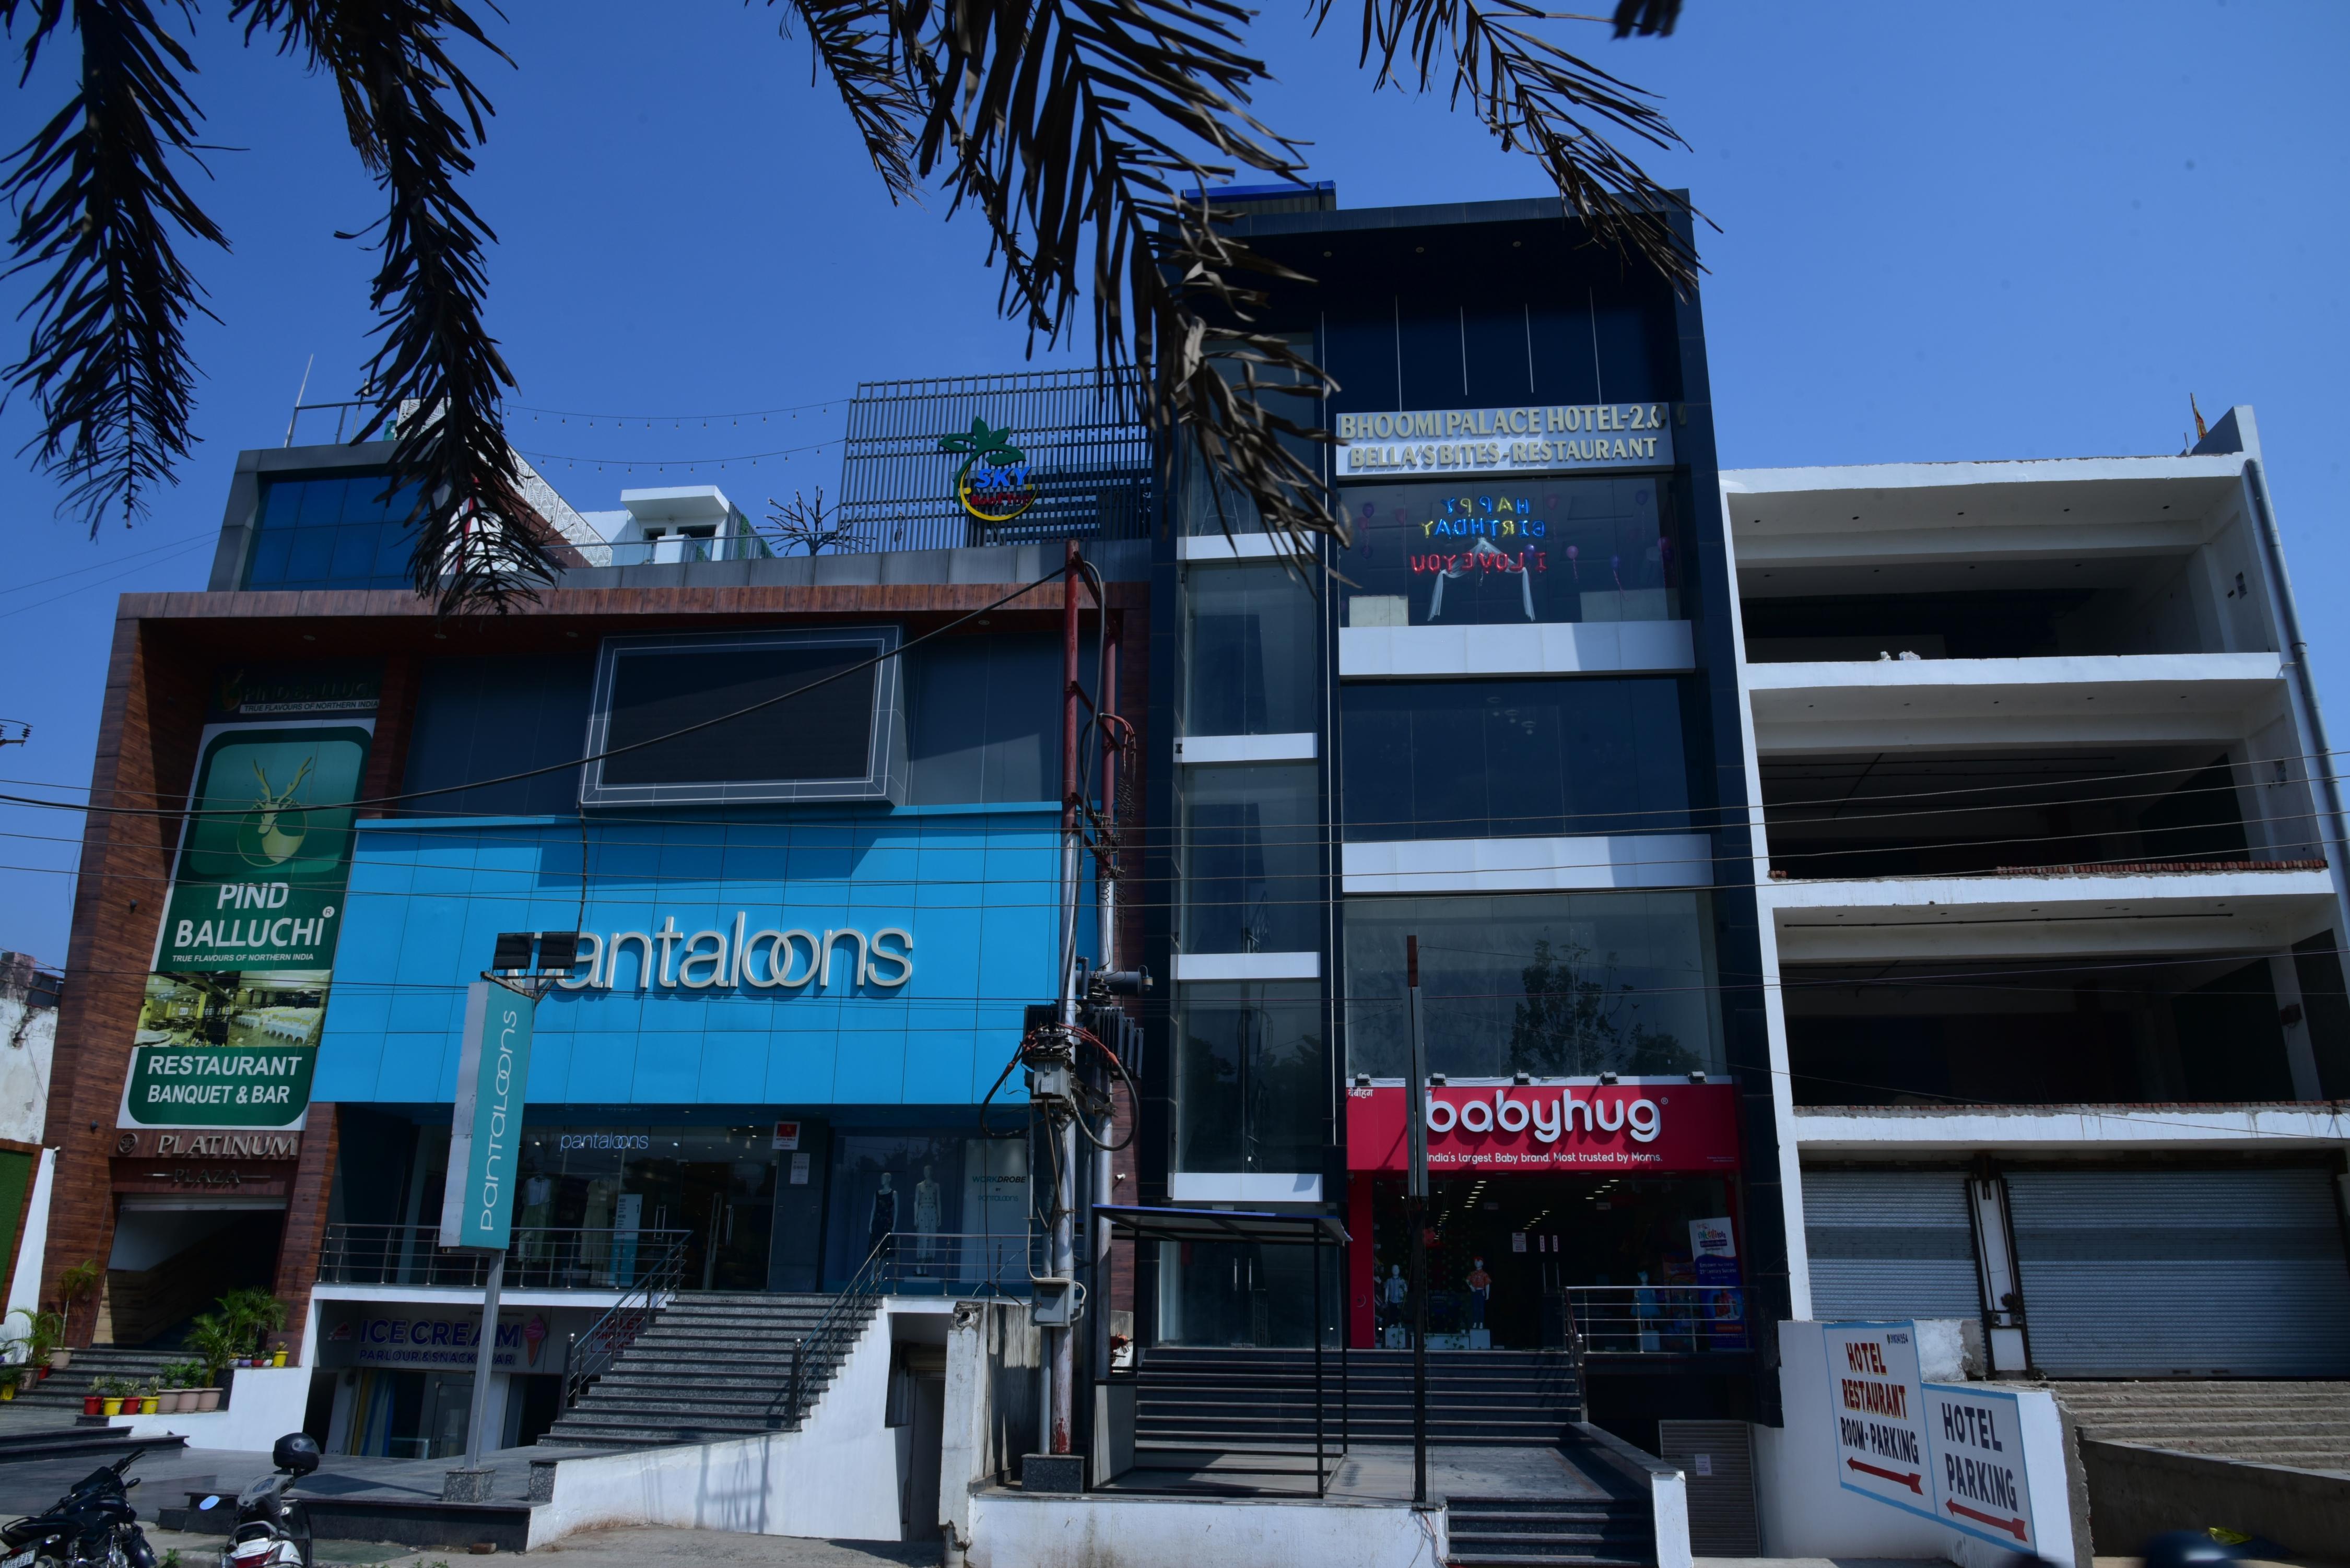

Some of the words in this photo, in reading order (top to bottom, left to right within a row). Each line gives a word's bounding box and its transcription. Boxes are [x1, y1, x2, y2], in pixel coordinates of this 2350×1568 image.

[1341, 412, 1441, 439] BHOOMI
[1446, 408, 1541, 436] PALACE
[1350, 445, 1436, 467] BELLA'S
[975, 466, 1032, 489] SKY
[217, 882, 290, 910] PIND
[174, 917, 325, 948] BALLUCHI
[506, 911, 913, 988] antaloons
[148, 1055, 302, 1076] RESTAURANT
[147, 1085, 233, 1105] BANQUET
[236, 1087, 248, 1104] &
[252, 1086, 290, 1104] BAR
[1426, 1089, 1661, 1142] babyhug
[158, 1134, 298, 1157] PLATINUM
[560, 1131, 649, 1152] pantaloons
[1426, 1151, 1455, 1162] India's
[1459, 1153, 1492, 1164] largest
[1495, 1153, 1518, 1164] Baby
[1521, 1153, 1550, 1162] brand.
[1554, 1152, 1576, 1162] Most
[1579, 1152, 1614, 1162] trusted
[1617, 1152, 1628, 1164] by
[1631, 1152, 1663, 1162] Moms.
[173, 1168, 241, 1184] PLAZA
[360, 1319, 408, 1345] ICE
[360, 1350, 418, 1362] PARLOUR
[421, 1351, 430, 1362] &
[492, 1355, 515, 1365] AR
[1846, 1342, 1887, 1376] HOTEL
[1841, 1378, 1908, 1420] RESTAURANT
[1941, 1402, 2003, 1453] HOTEL
[1945, 1453, 2018, 1513] PARKING
